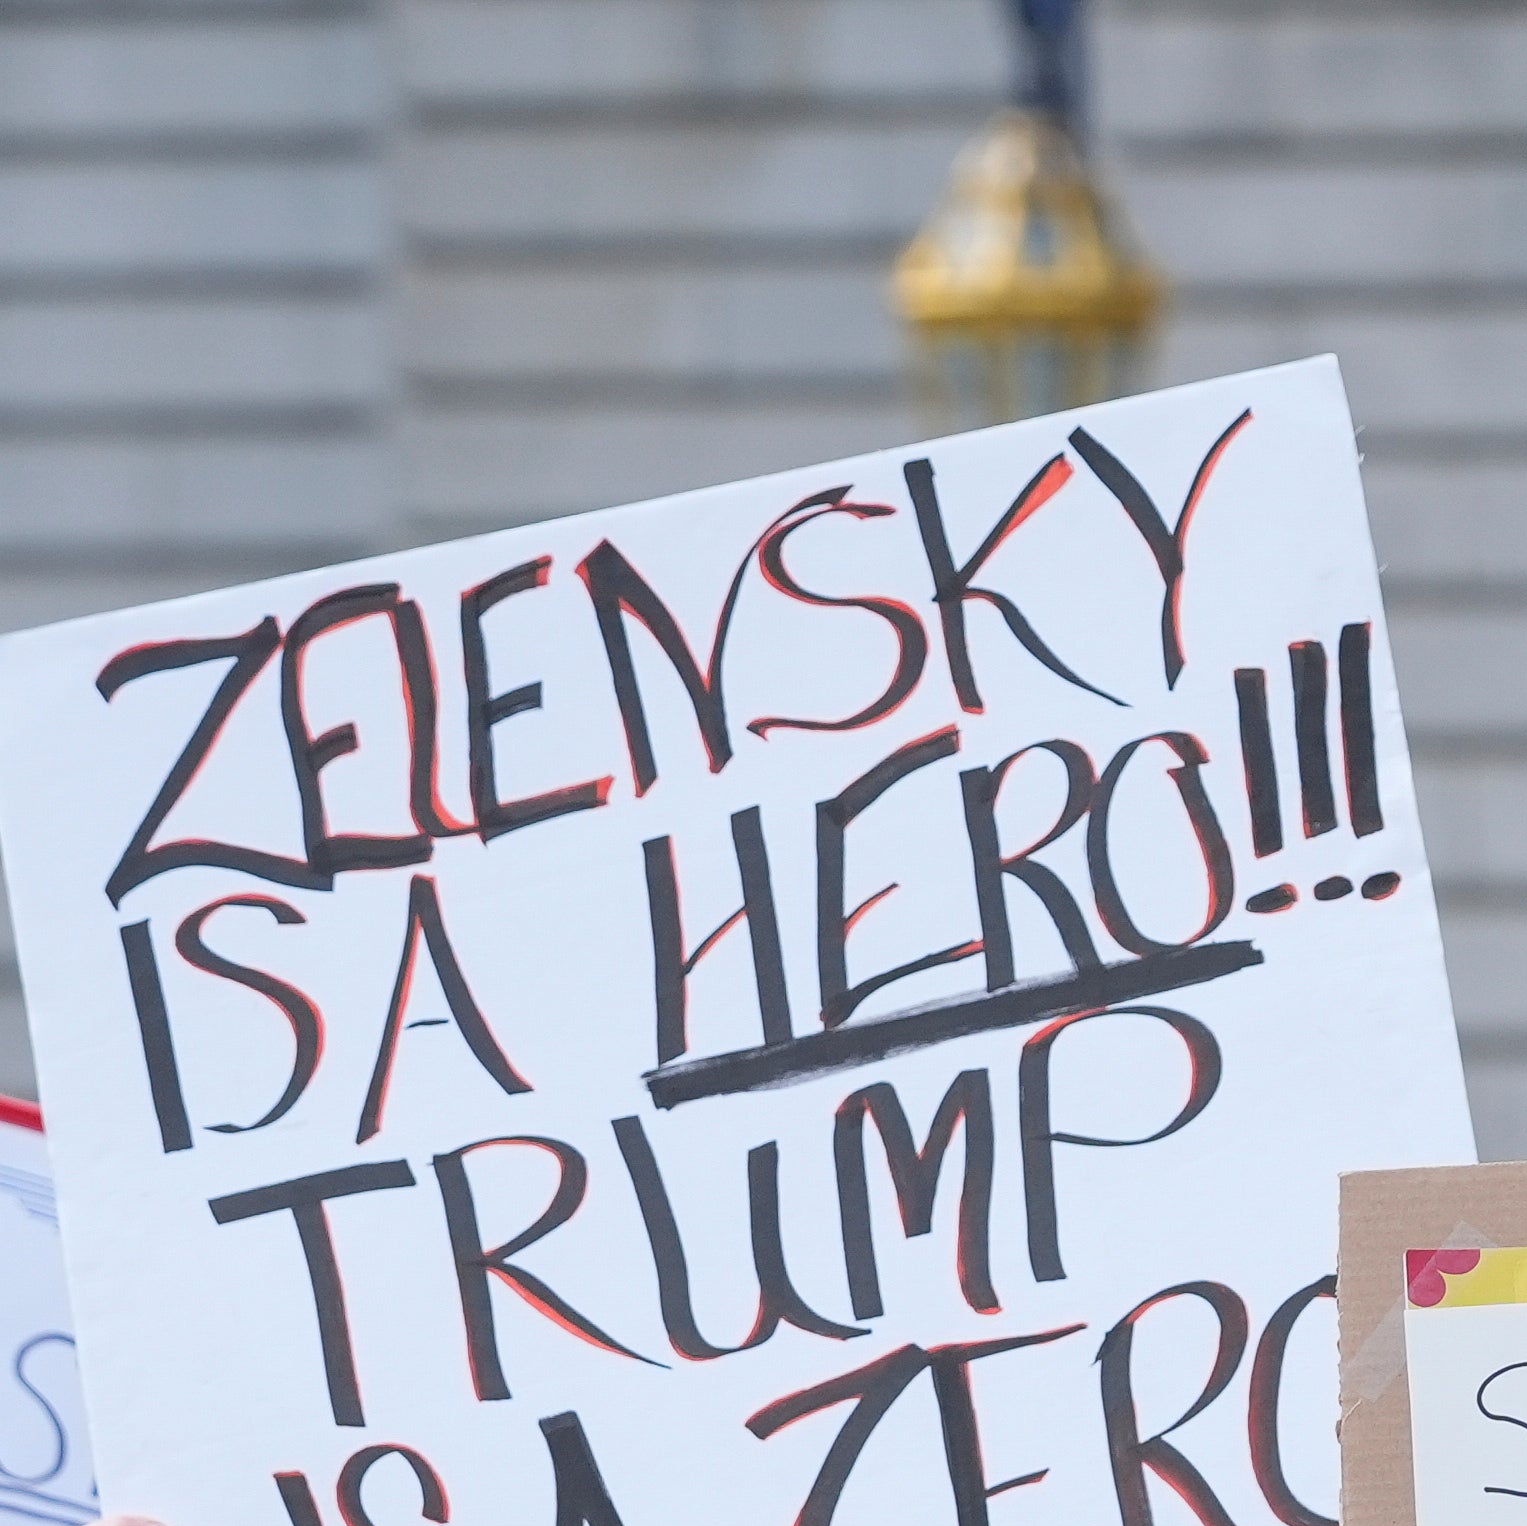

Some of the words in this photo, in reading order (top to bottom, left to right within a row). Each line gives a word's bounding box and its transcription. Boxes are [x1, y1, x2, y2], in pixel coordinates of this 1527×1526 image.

[96, 409, 1252, 908] ZELENSKY
[120, 893, 325, 1152] IS
[356, 874, 534, 1144] A
[208, 1006, 1222, 1428] TRUMP
